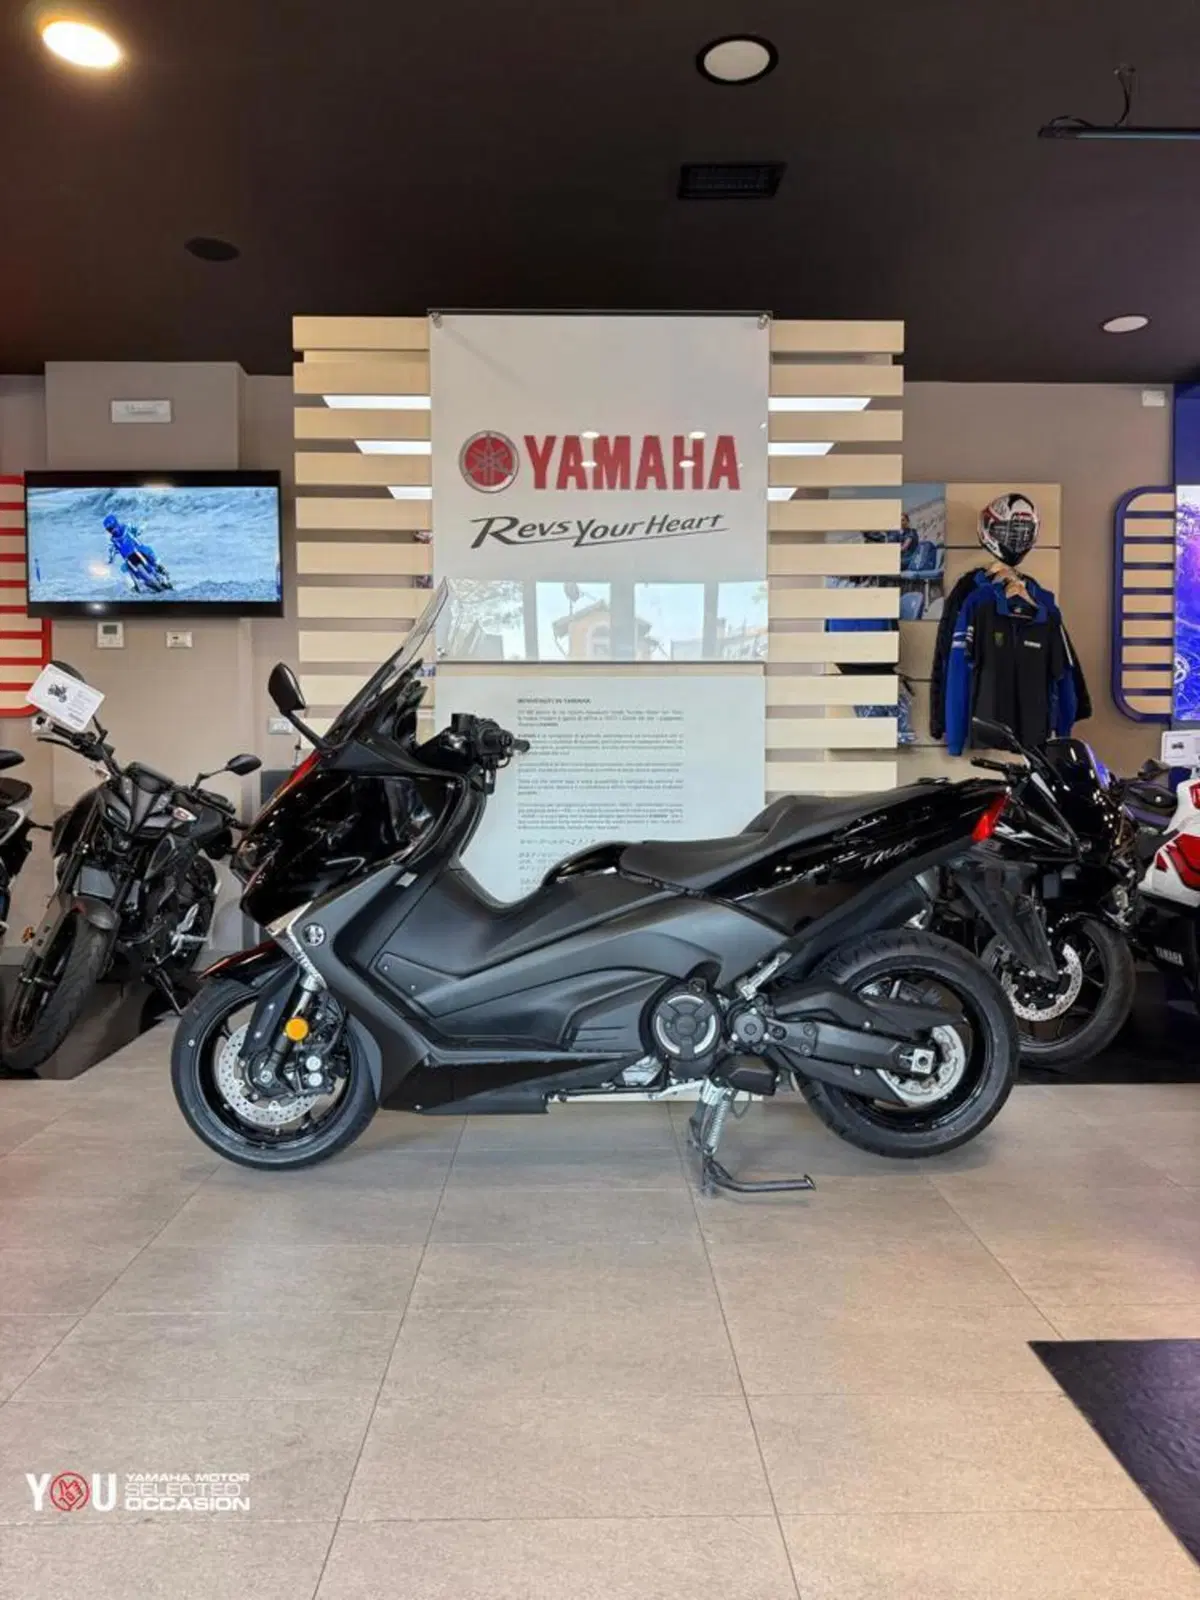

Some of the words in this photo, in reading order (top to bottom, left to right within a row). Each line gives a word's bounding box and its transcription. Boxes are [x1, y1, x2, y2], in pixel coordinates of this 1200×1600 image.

[523, 435, 741, 490] YAMAHA
[469, 515, 573, 549] Revs
[573, 518, 645, 547] Your
[645, 513, 725, 535] Heart
